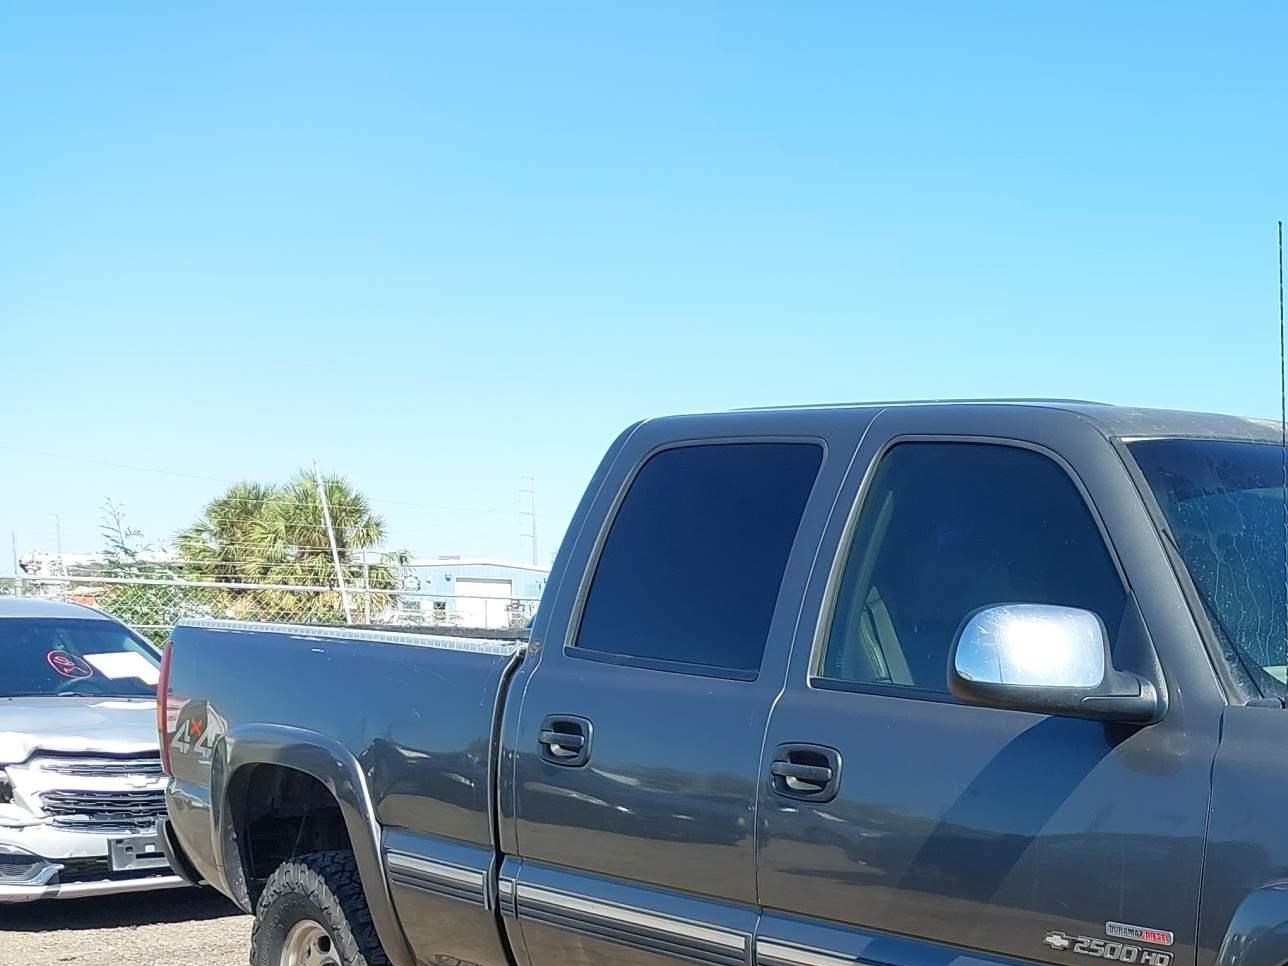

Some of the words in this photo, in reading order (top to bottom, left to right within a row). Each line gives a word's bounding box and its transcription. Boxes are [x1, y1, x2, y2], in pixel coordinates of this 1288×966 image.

[1108, 924, 1143, 939] DURAMAX
[1143, 929, 1170, 944] DIESEL
[1074, 937, 1138, 963] 2500
